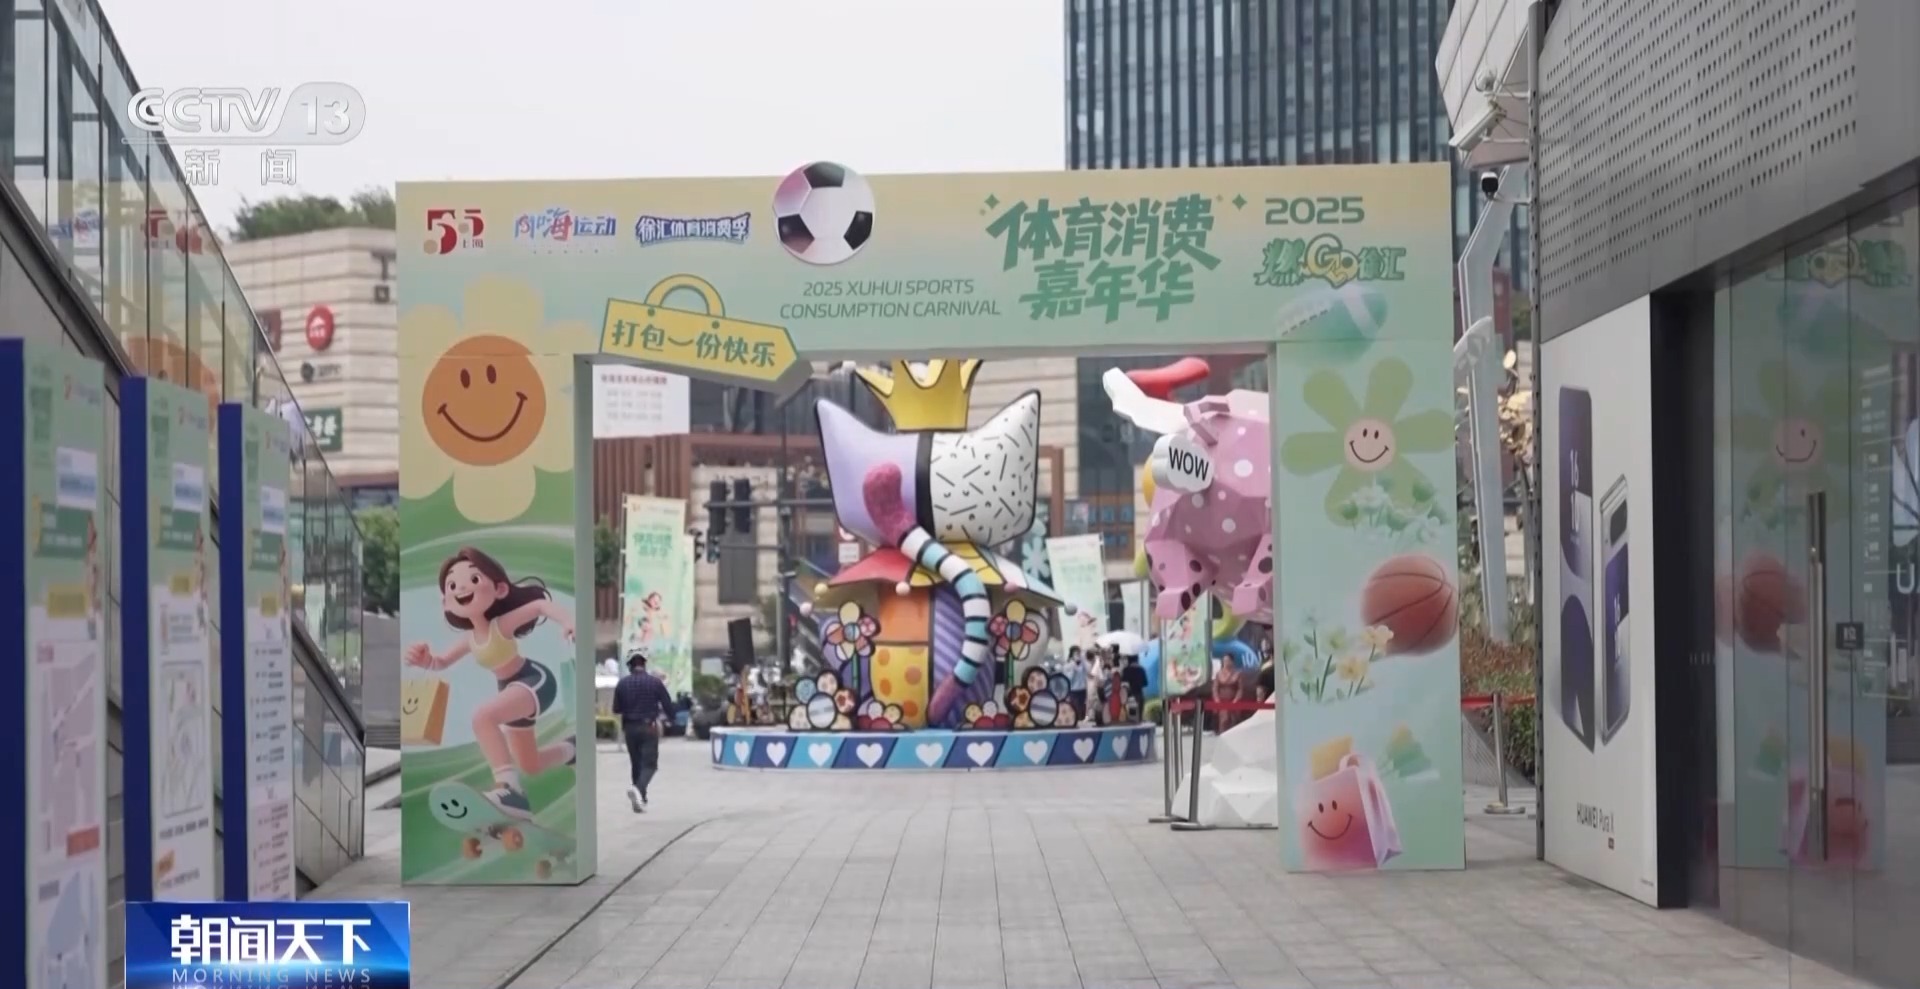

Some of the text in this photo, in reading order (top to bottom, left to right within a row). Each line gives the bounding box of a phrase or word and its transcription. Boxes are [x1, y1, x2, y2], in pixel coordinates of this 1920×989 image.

[1265, 196, 1365, 225] 2025
[636, 212, 752, 246] 徐汇体育消费季
[985, 193, 1222, 272] 体育消费
[803, 279, 974, 297] 2025 XUHUI SPORTS
[1018, 257, 1195, 324] 嘉年华
[779, 300, 1001, 319] CONSUMPTION CARNIVAL
[611, 319, 776, 368] 打包一份快乐
[1169, 446, 1209, 481] WOW
